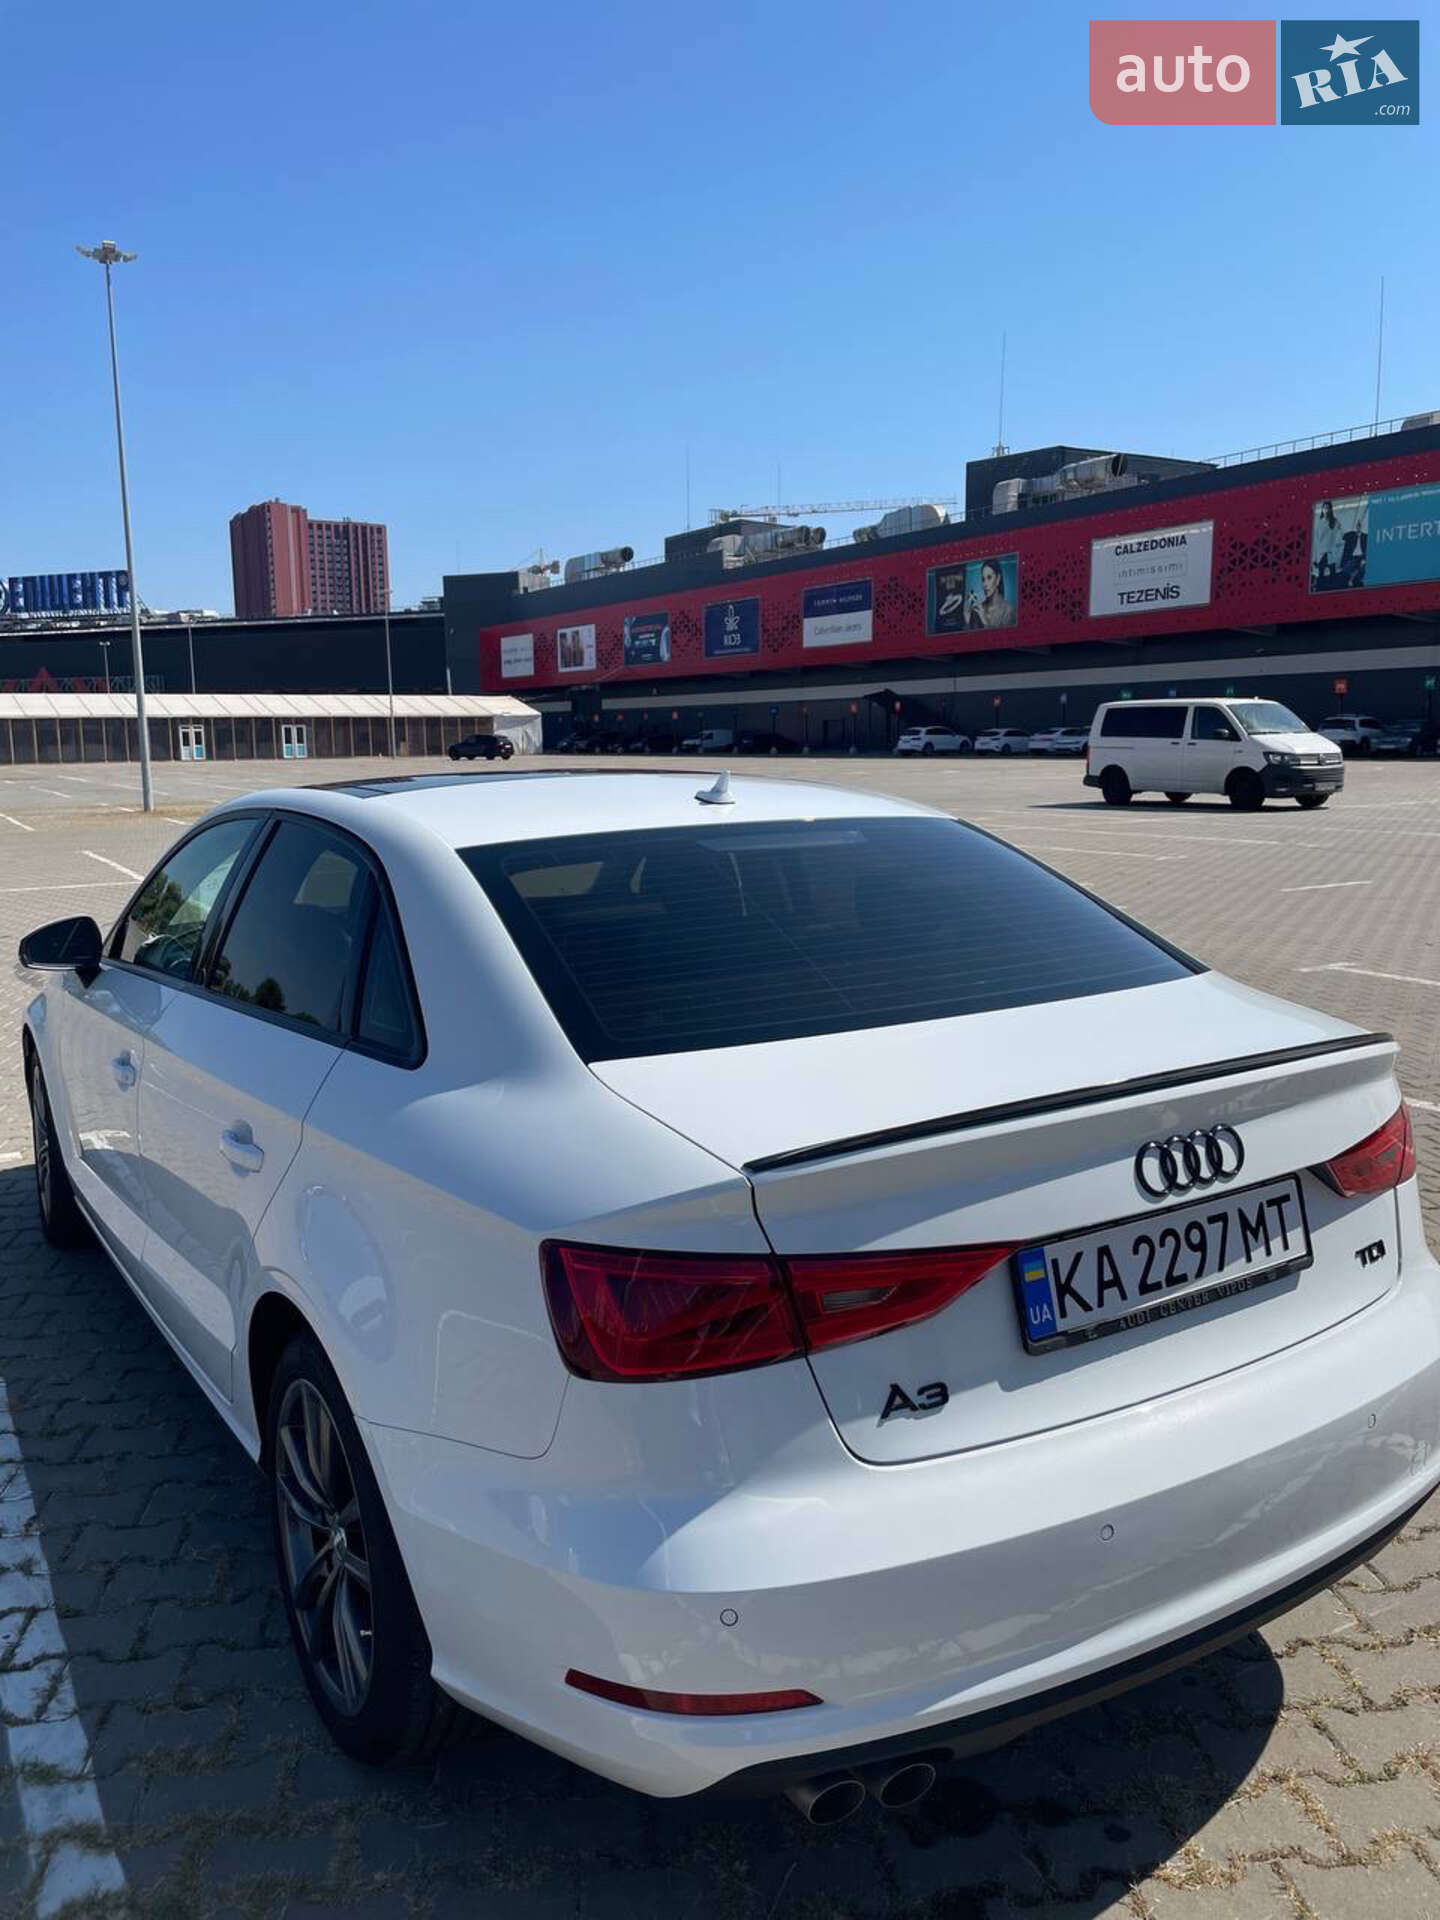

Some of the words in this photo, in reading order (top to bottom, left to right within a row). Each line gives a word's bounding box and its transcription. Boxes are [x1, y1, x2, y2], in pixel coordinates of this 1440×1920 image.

[1115, 534, 1188, 556] CALZEDONIA
[1051, 1244, 1128, 1319] KA
[1132, 1211, 1229, 1296] 2297
[1237, 1193, 1291, 1263] MT
[1354, 1239, 1386, 1268] TDI
[1029, 1307, 1052, 1325] UA
[880, 1382, 950, 1420] A3
